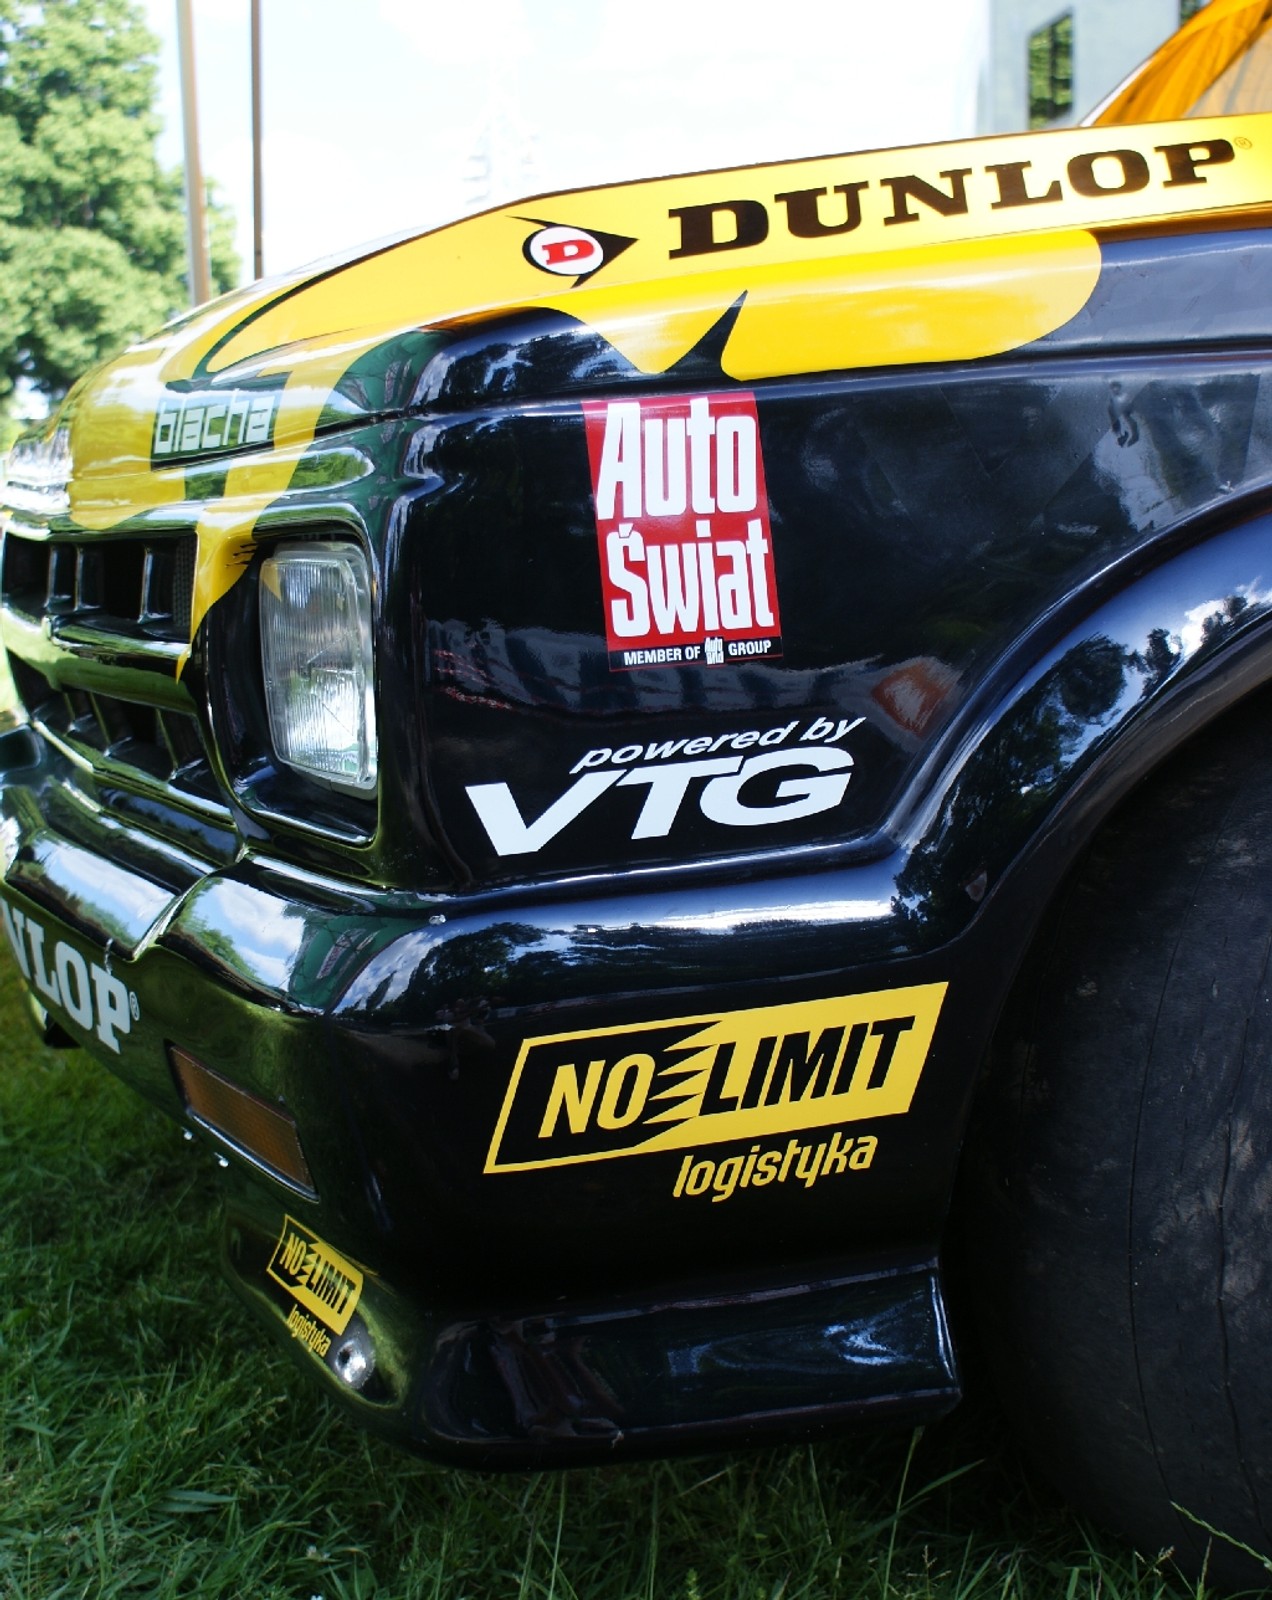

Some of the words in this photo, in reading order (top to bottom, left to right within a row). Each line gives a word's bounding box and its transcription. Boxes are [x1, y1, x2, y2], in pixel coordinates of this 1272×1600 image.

[541, 239, 595, 265] D
[154, 388, 276, 454] blacha
[597, 397, 757, 520] Auto
[606, 519, 775, 638] Świat
[624, 647, 682, 665] MEMBER
[684, 646, 701, 660] OF
[729, 640, 772, 656] GROUP
[569, 720, 800, 774] powered
[800, 716, 866, 743] by
[464, 746, 855, 857] VTG
[538, 1053, 656, 1139] NO
[698, 1015, 916, 1117] LIMIT
[672, 1132, 878, 1203] logistyka
[279, 1232, 307, 1276] NO
[305, 1254, 357, 1315] LIMIT
[286, 1304, 332, 1358] logistyka
